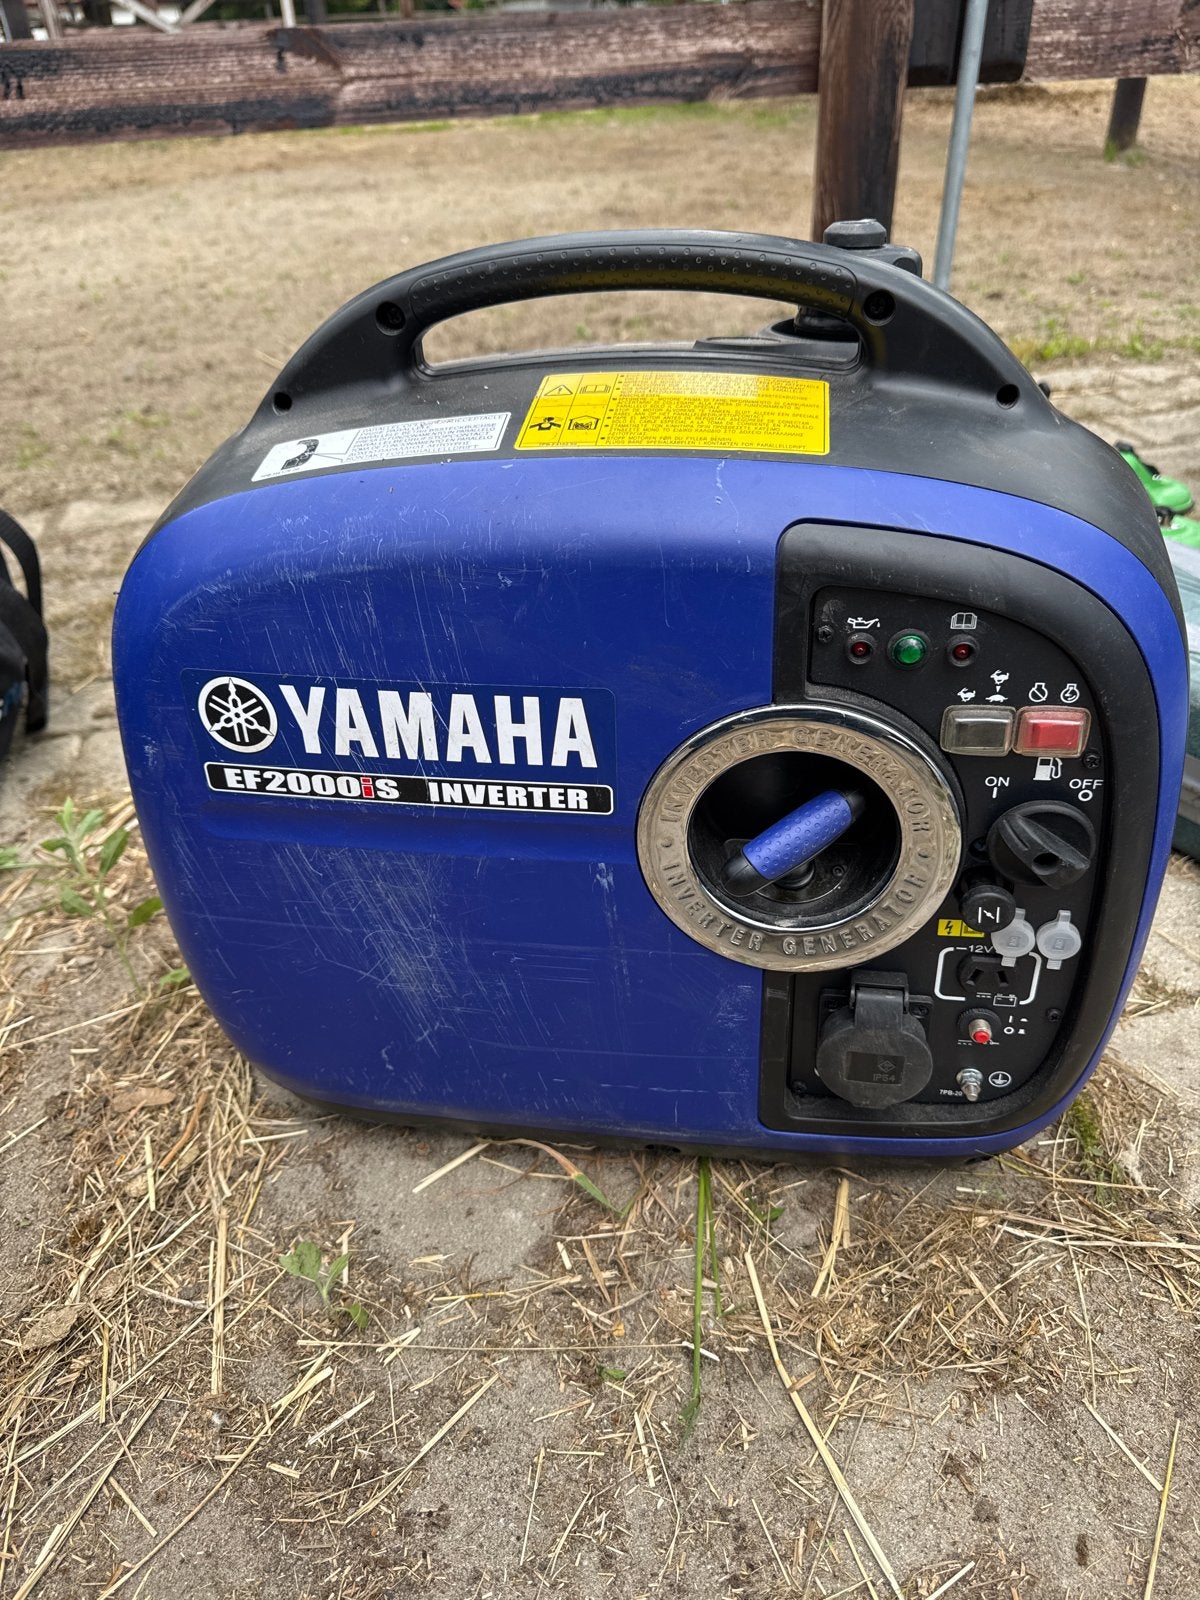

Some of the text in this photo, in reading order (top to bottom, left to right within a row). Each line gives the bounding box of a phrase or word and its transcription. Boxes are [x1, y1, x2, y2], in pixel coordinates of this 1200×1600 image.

[278, 684, 598, 769] YAMAHA
[223, 767, 590, 811] EF2000iS INVERTER
[661, 727, 932, 833] INVERTER GENERATOR
[984, 776, 1010, 788] ON
[1069, 778, 1104, 790] OFF
[663, 863, 928, 957] INVERTER GENERATOR
[968, 944, 993, 954] 12V
